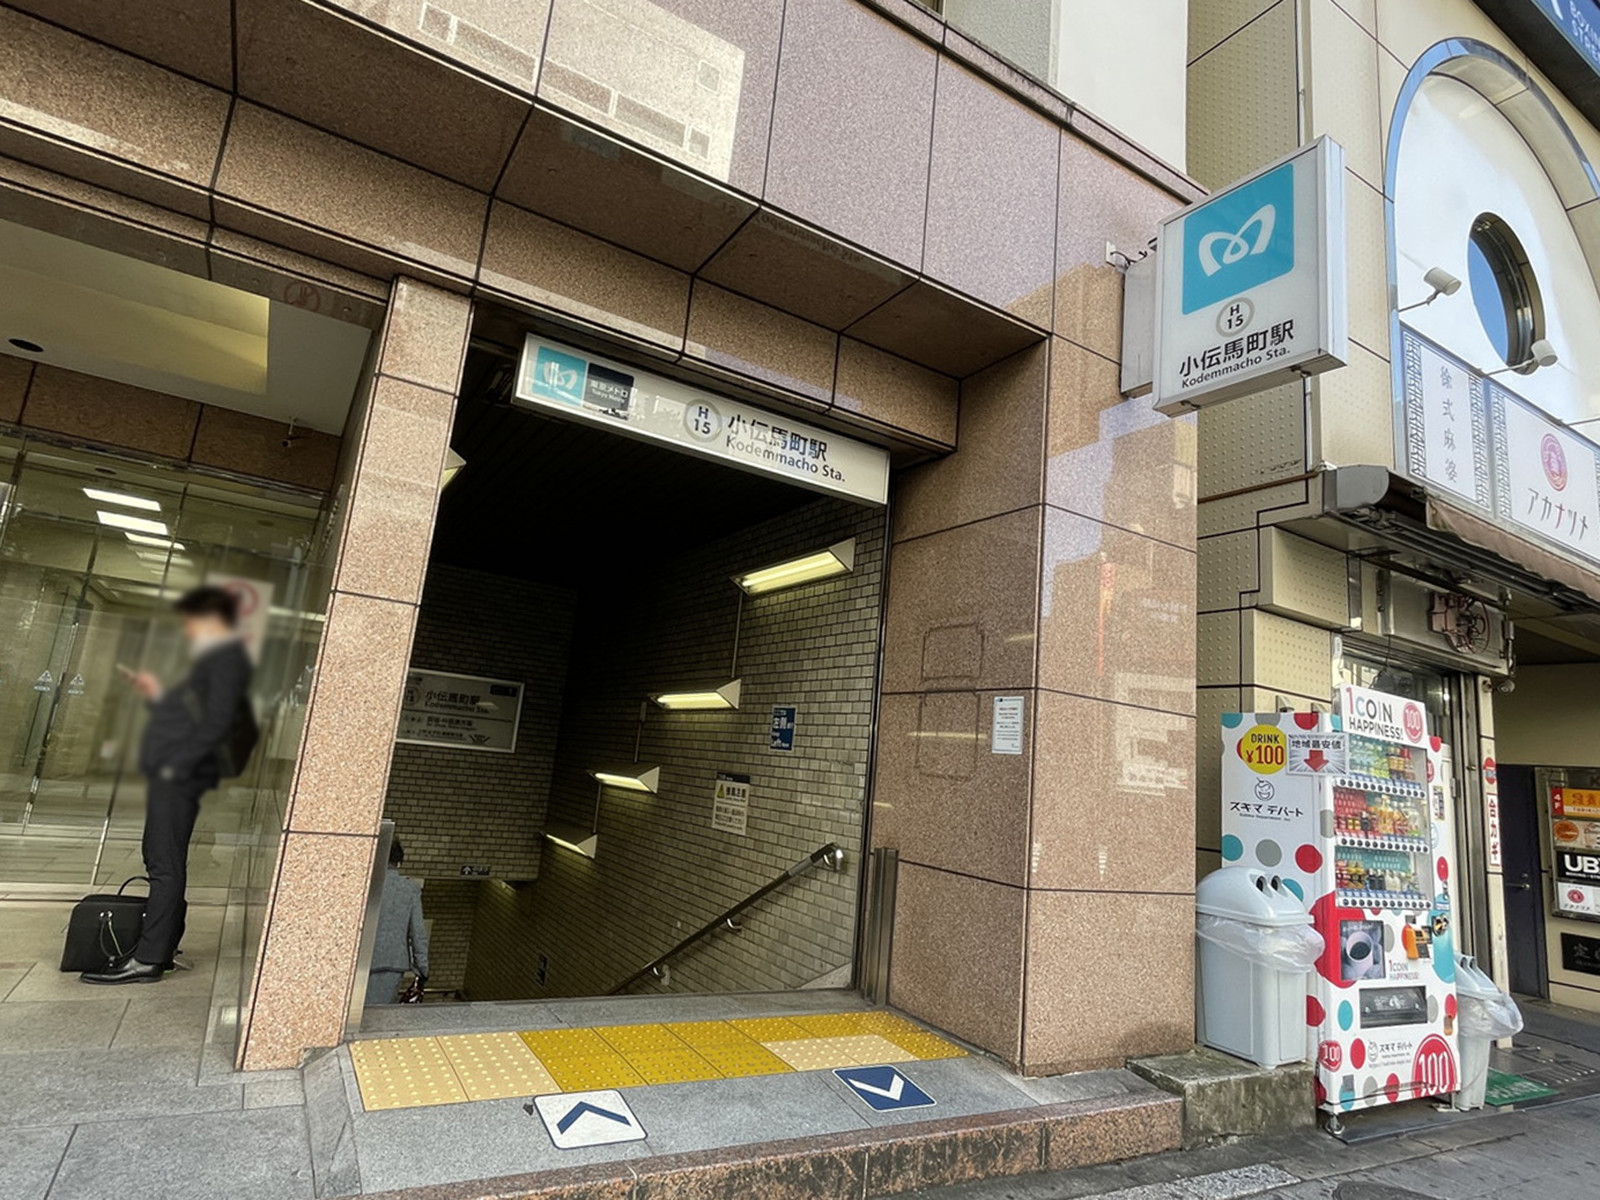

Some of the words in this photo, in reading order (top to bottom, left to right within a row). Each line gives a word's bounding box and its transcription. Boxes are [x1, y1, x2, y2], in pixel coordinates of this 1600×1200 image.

[1229, 303, 1241, 316] H
[1227, 316, 1244, 330] 15
[1179, 318, 1295, 378] 小伝馬町駅
[1181, 353, 1262, 389] Kodemmacho
[1265, 346, 1291, 361] Sta.
[697, 406, 710, 420] H
[692, 417, 711, 436] 15
[727, 414, 828, 463] 小伝馬町駅
[725, 434, 820, 474] Kodemmacho
[821, 464, 847, 483] Sta.
[1250, 733, 1280, 743] DRINK
[1348, 716, 1404, 741] HAPPINESS!
[1291, 739, 1342, 749] 地域最安値
[1245, 744, 1285, 766] ¥100
[1229, 801, 1263, 814] スキマ
[1267, 805, 1304, 817] デパート
[1564, 853, 1600, 874] UB
[1322, 1043, 1341, 1062] 100
[1418, 1050, 1450, 1098] 100
